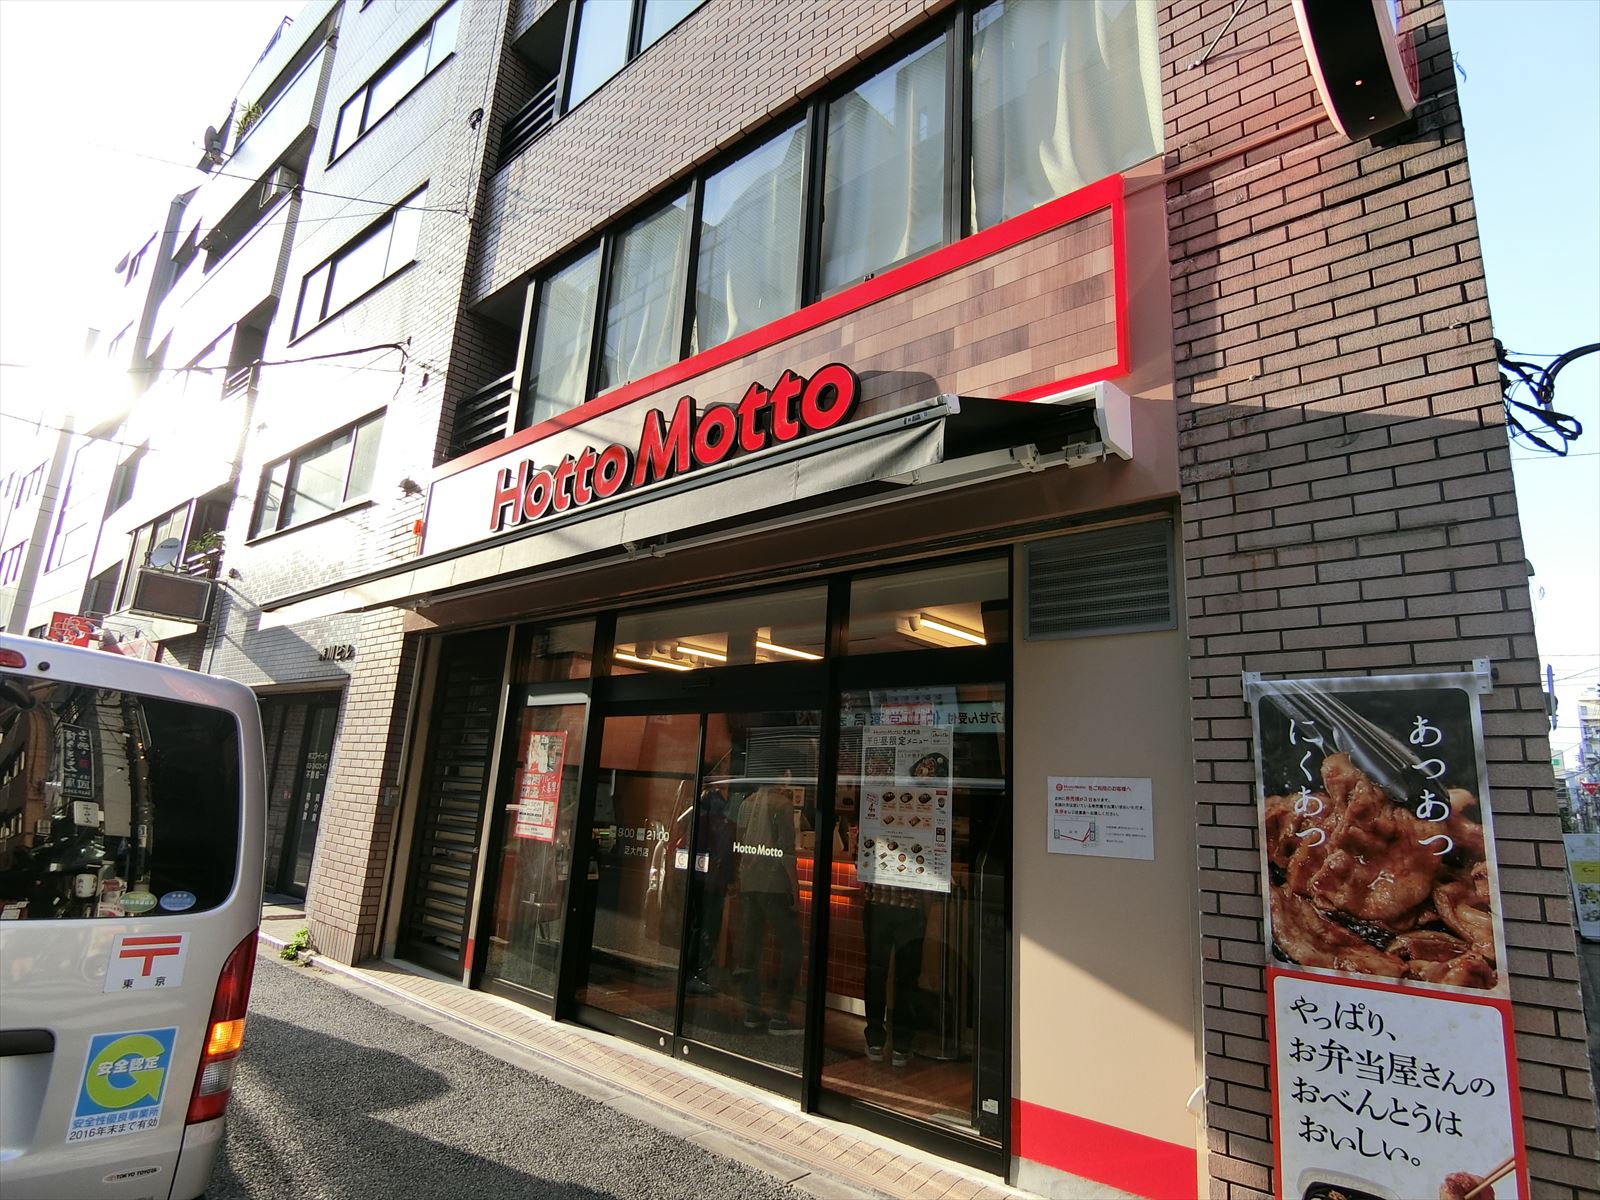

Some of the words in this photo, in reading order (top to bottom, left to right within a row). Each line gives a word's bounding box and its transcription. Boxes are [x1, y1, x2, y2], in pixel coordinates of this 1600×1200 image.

[1288, 718, 1327, 847] にくあつ
[1409, 715, 1454, 857] あつあつ
[1289, 994, 1397, 1041] やっぱり、
[96, 1056, 160, 1076] 安全認定
[1289, 1037, 1496, 1098] お弁当屋さんの
[69, 1117, 158, 1141] 2016年末まで有効
[72, 1107, 159, 1130] 安全性優良事業所
[1291, 1076, 1463, 1138] おべんとうは
[1297, 1115, 1422, 1168] おいしい。
